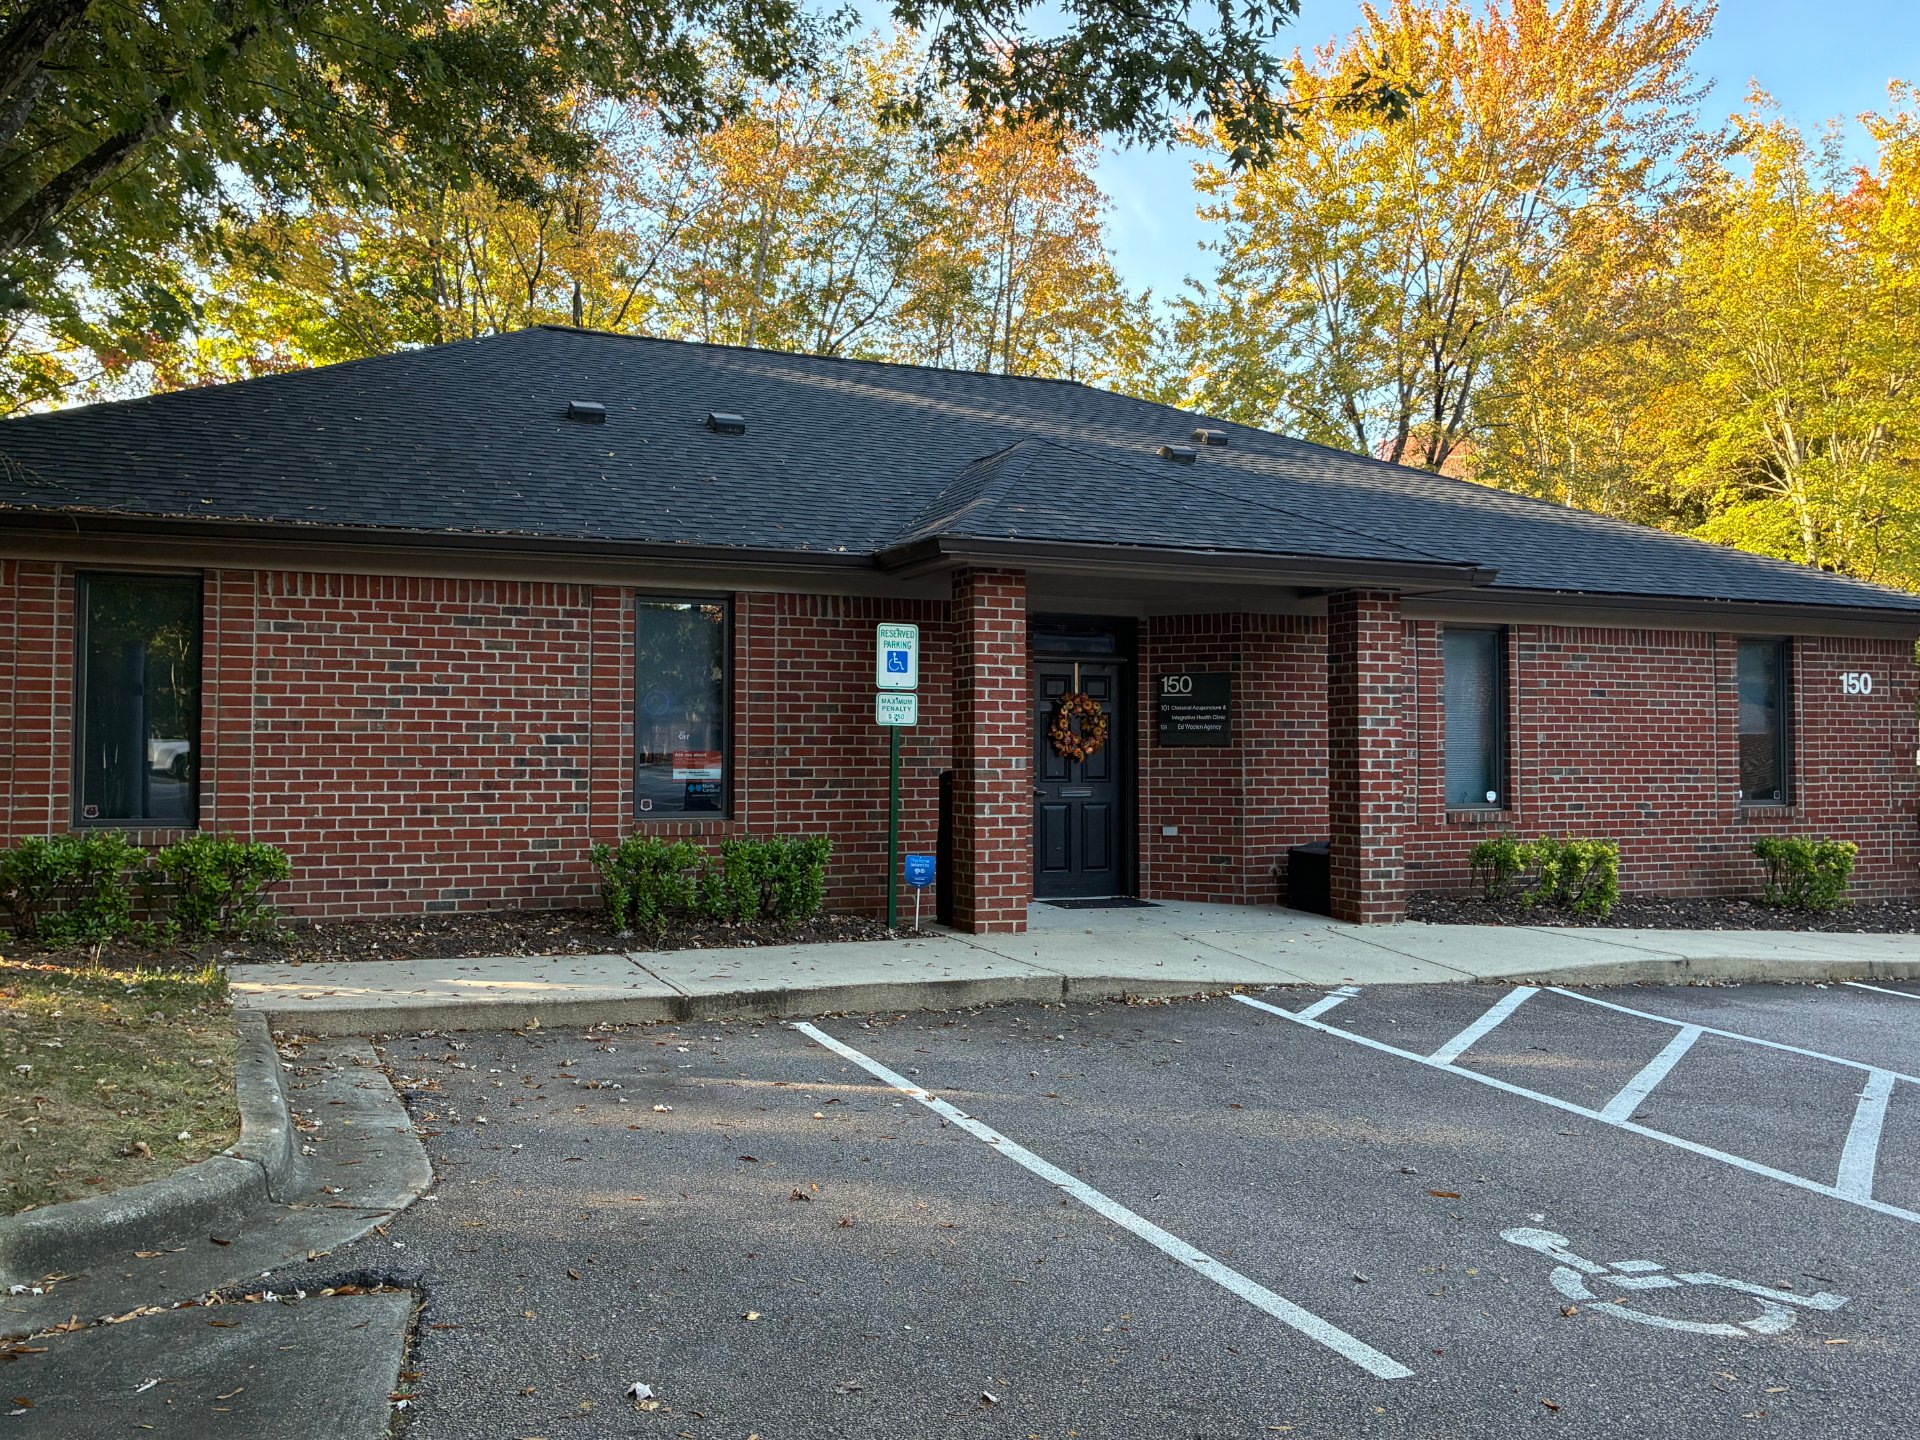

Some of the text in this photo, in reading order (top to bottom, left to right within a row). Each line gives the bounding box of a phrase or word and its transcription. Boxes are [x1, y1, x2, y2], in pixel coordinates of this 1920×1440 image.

[880, 629, 915, 639] RESERVED
[883, 640, 912, 649] PARKING
[1161, 675, 1193, 693] 150
[1839, 672, 1872, 695] 150
